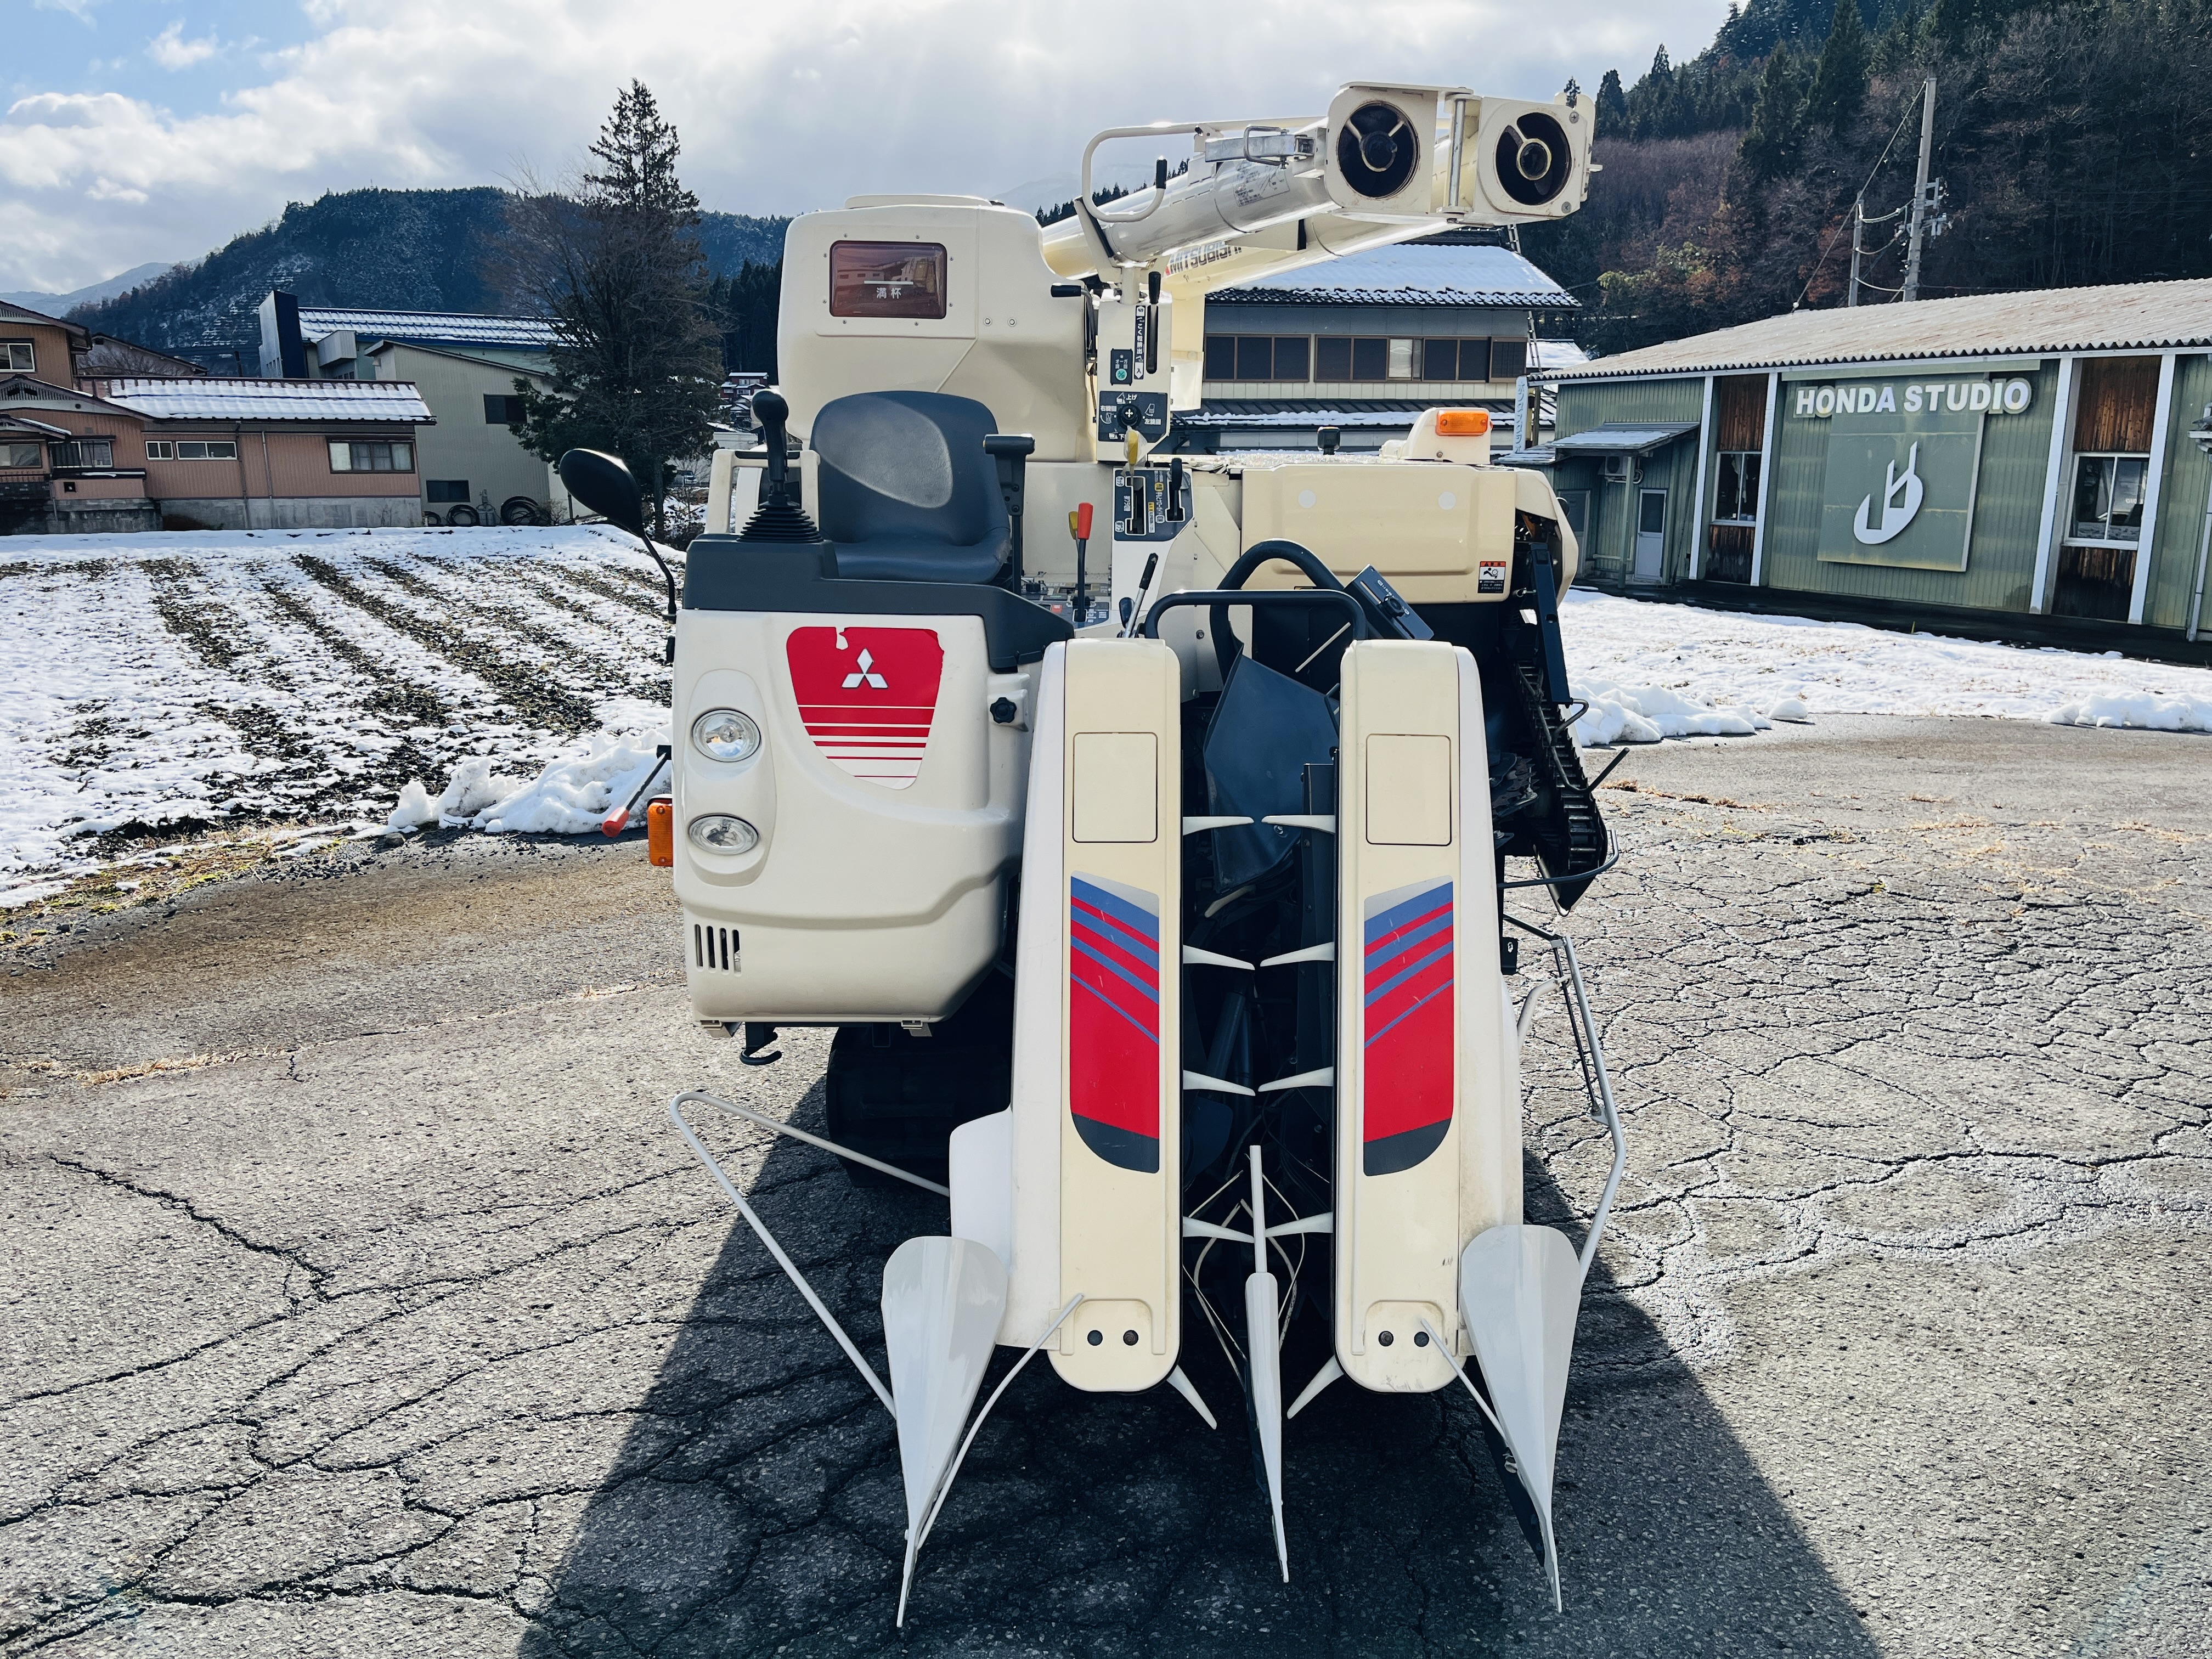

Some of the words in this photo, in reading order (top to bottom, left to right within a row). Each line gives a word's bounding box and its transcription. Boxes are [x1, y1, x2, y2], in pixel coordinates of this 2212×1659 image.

[876, 287, 901, 299] 満杯
[1796, 386, 1896, 414] HONDA
[1903, 381, 2029, 412] STUDIO
